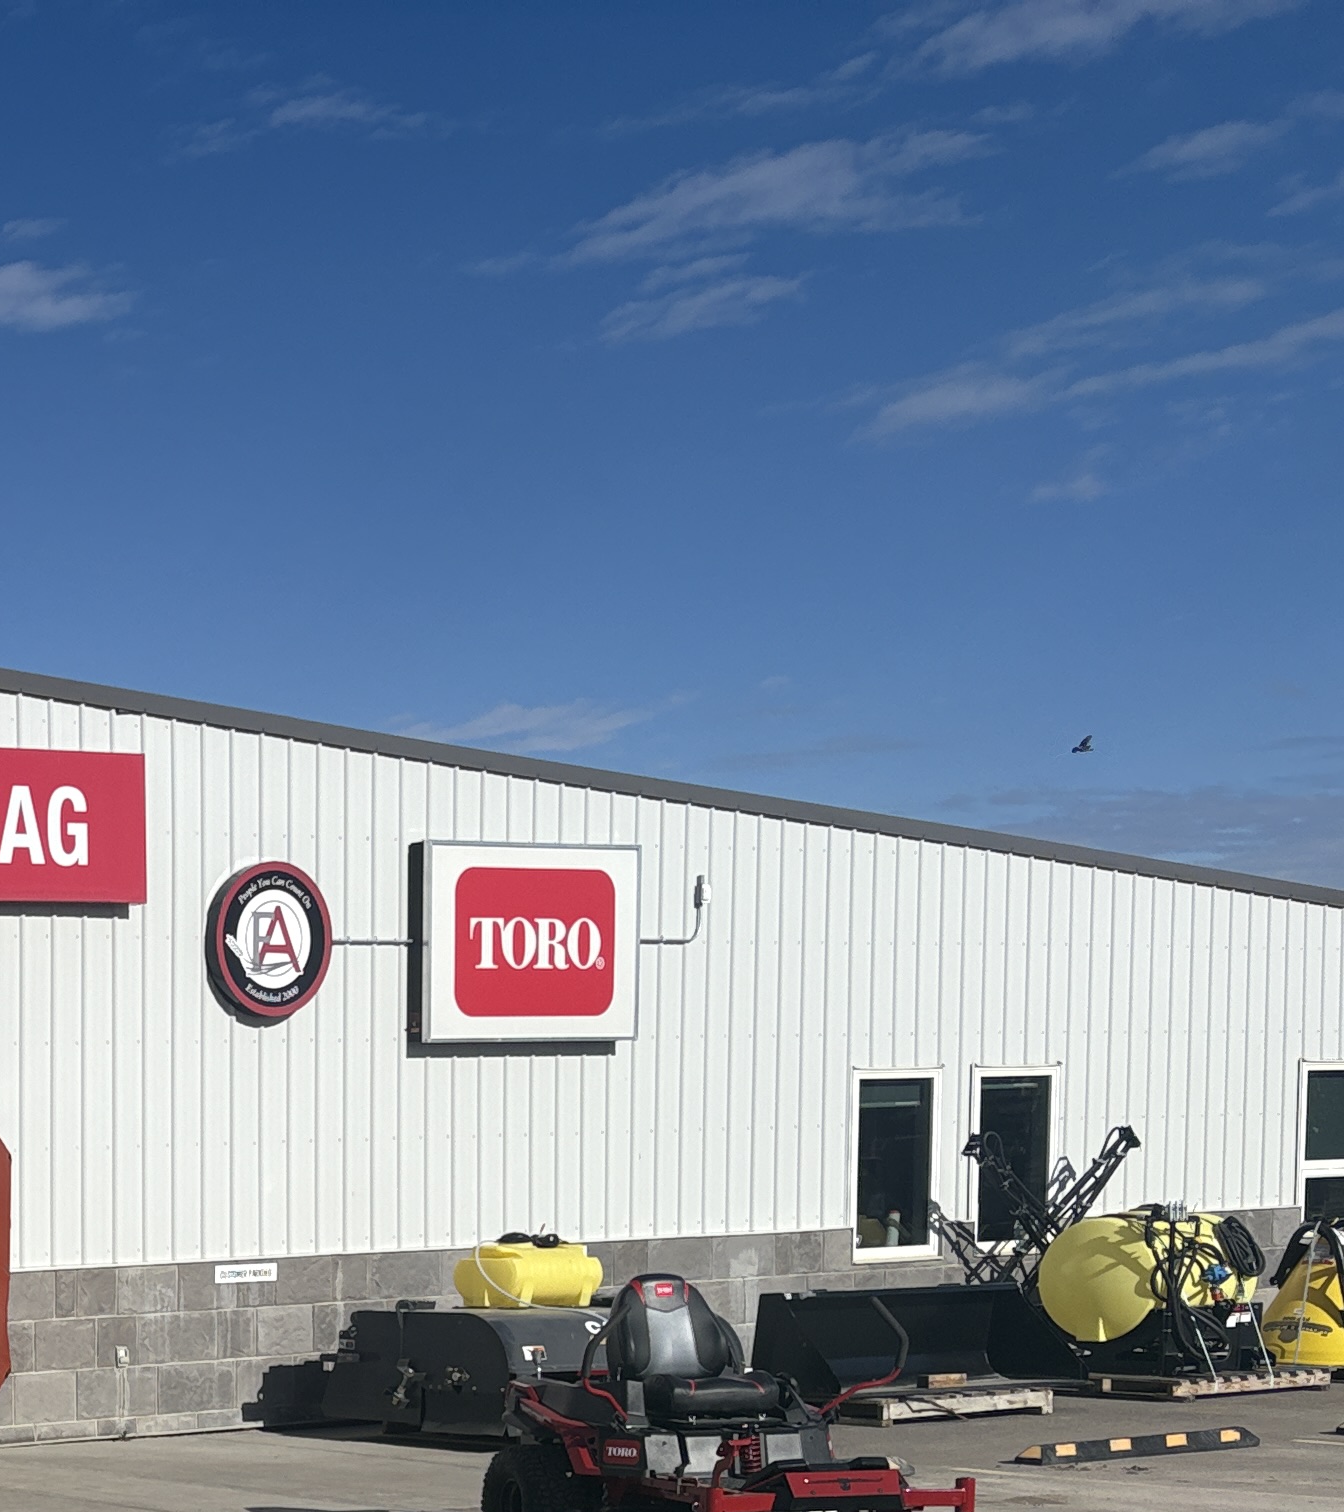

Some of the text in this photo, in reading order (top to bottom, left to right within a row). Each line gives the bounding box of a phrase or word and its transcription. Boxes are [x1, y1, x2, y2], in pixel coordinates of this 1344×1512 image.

[237, 875, 312, 910] People You Can Count On
[606, 1446, 638, 1458] TORO
